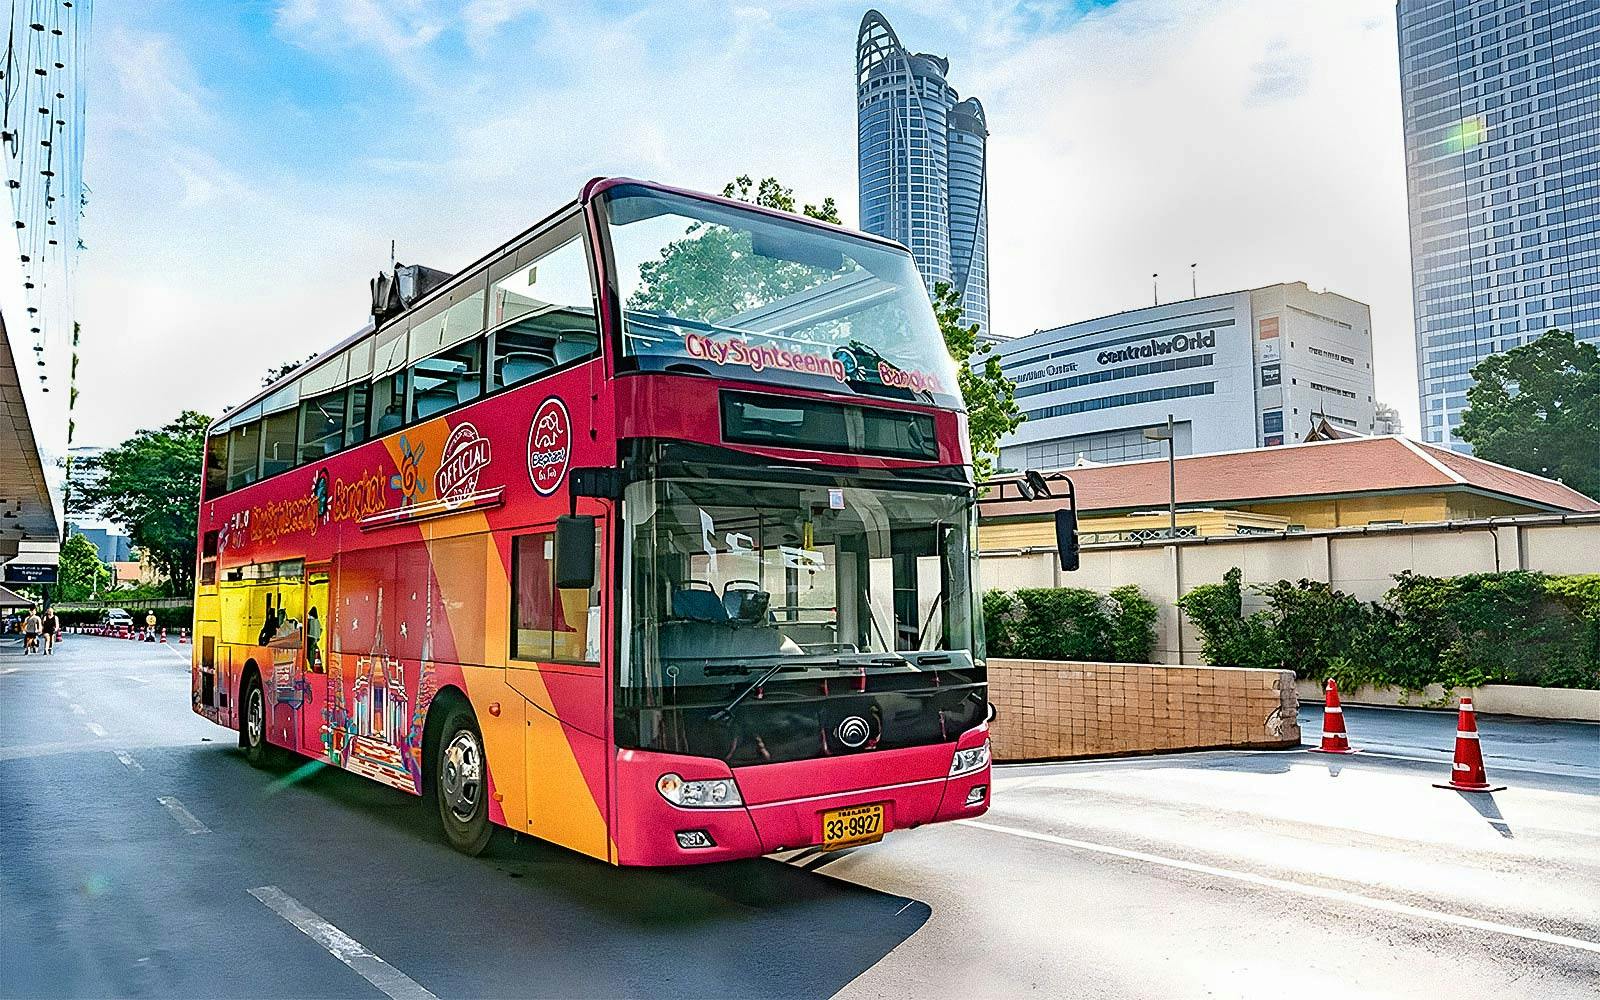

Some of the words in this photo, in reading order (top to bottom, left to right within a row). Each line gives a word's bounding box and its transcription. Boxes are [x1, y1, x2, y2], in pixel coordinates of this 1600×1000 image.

[686, 332, 728, 365] City
[730, 339, 846, 382] Sightseeing
[439, 442, 488, 494] OFFICIAL
[826, 813, 881, 839] 33-9927
